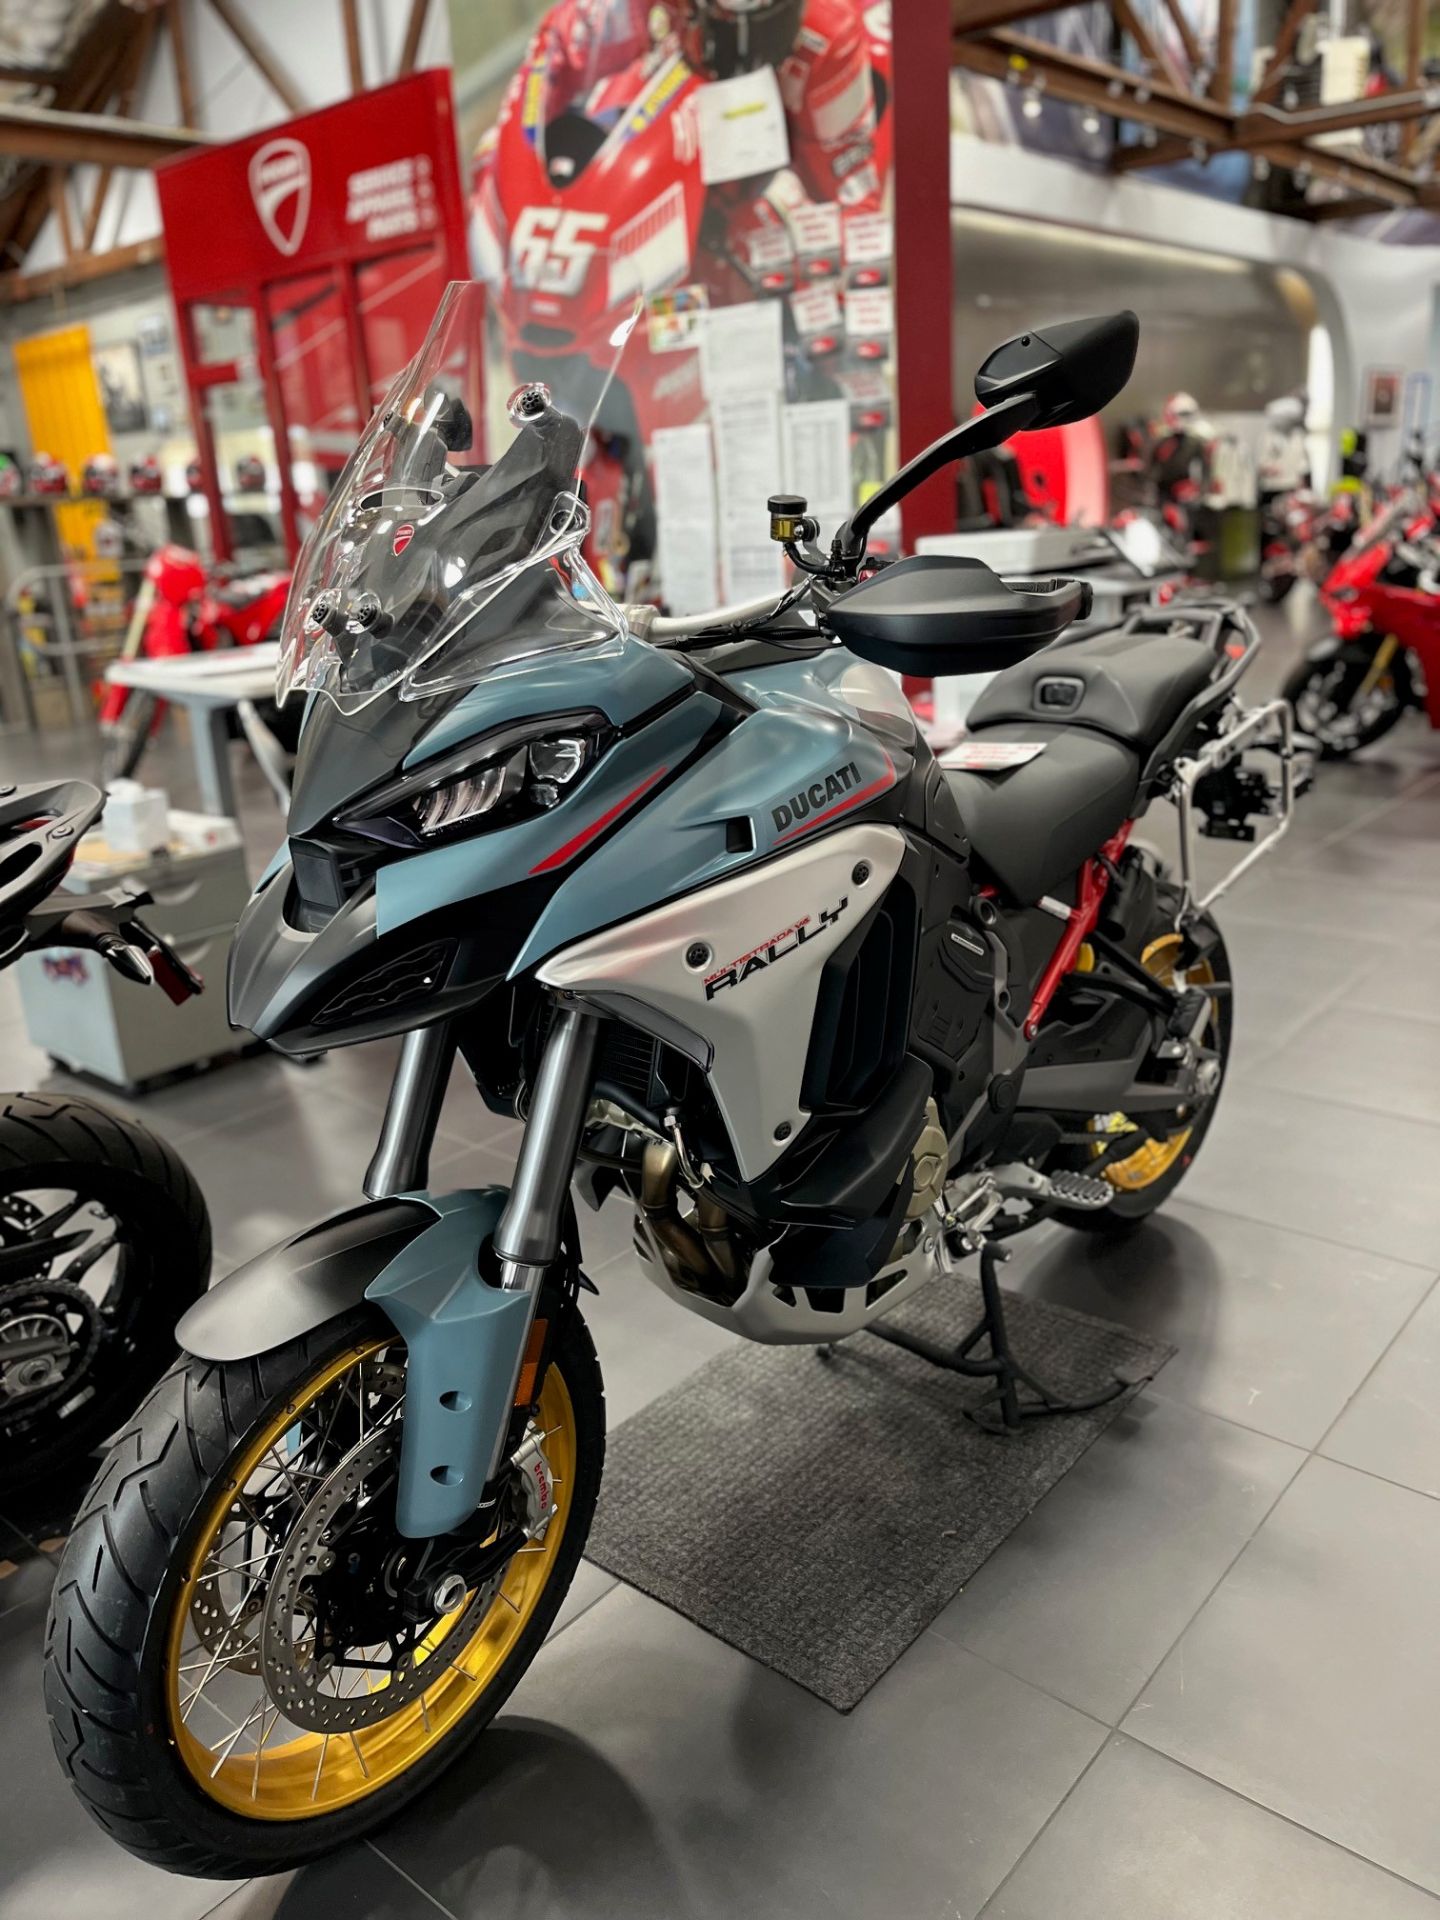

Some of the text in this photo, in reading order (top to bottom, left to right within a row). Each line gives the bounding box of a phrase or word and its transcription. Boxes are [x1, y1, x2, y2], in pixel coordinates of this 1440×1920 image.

[509, 206, 609, 297] 65
[771, 762, 862, 832] DUCATI
[703, 928, 794, 985] MULTISTRADA
[704, 897, 848, 1001] RALLY
[534, 1461, 549, 1509] brembo
